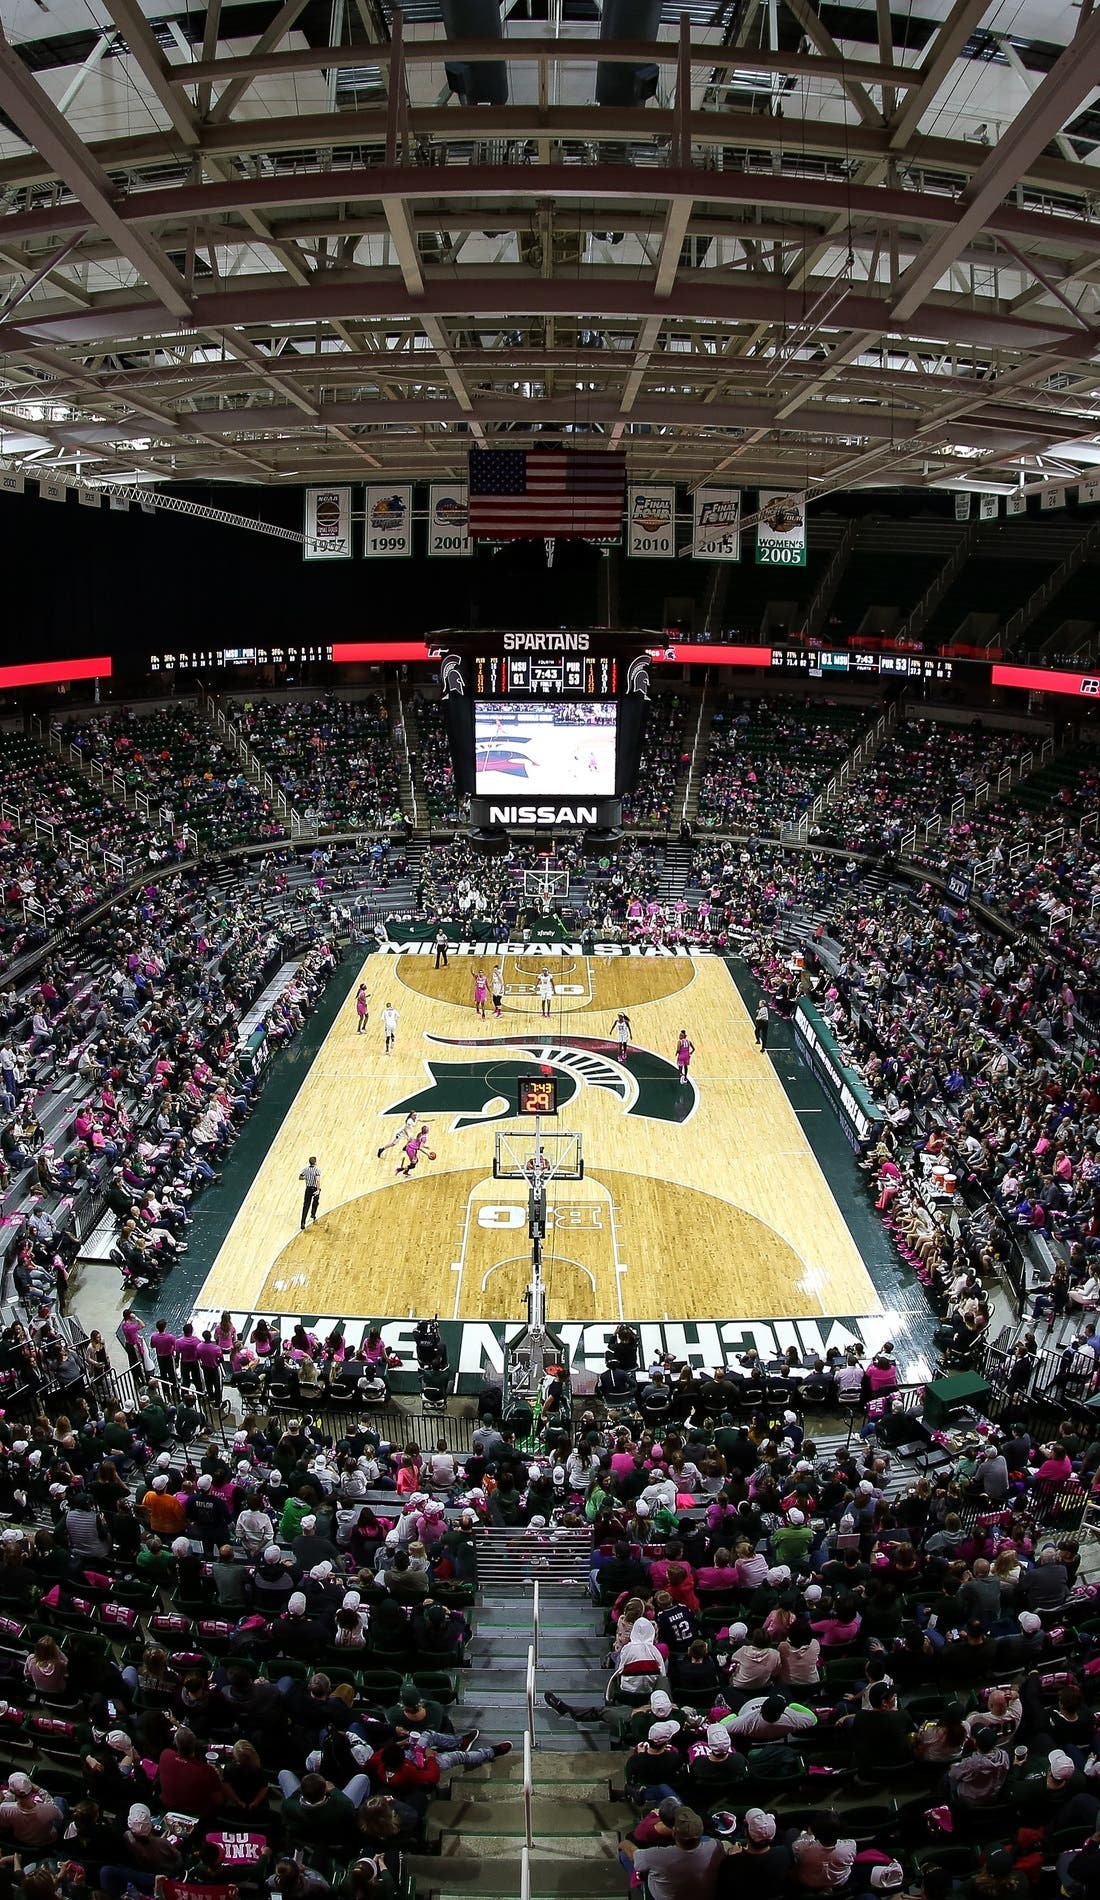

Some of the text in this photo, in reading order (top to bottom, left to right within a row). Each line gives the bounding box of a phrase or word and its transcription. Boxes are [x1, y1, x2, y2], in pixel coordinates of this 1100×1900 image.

[644, 499, 671, 509] FINAL
[712, 502, 736, 513] FINAL
[634, 507, 671, 520] FOUR
[703, 511, 736, 523] FOUR
[313, 539, 346, 553] 1957
[371, 537, 406, 551] 1999
[433, 536, 469, 550] 2001
[633, 538, 670, 551] 2010
[698, 541, 733, 555] 2015
[759, 538, 804, 549] WOMEN'S
[760, 547, 802, 564] 2005
[503, 633, 590, 650] SPARTANS
[834, 655, 848, 666] MSU
[855, 655, 873, 664] 7:43
[881, 658, 907, 671] PUR 53
[511, 662, 527, 672] MSU
[566, 662, 581, 672] PUR
[535, 669, 558, 679] 7:43
[568, 673, 580, 685] 53
[490, 807, 598, 824] NISSAN
[377, 942, 718, 957] MICHIGAN STATE
[531, 1082, 553, 1093] 7:43
[526, 1093, 549, 1111] 29
[668, 1611, 684, 1623] BRADY
[672, 1620, 693, 1641] 12
[218, 1843, 260, 1859] INK
